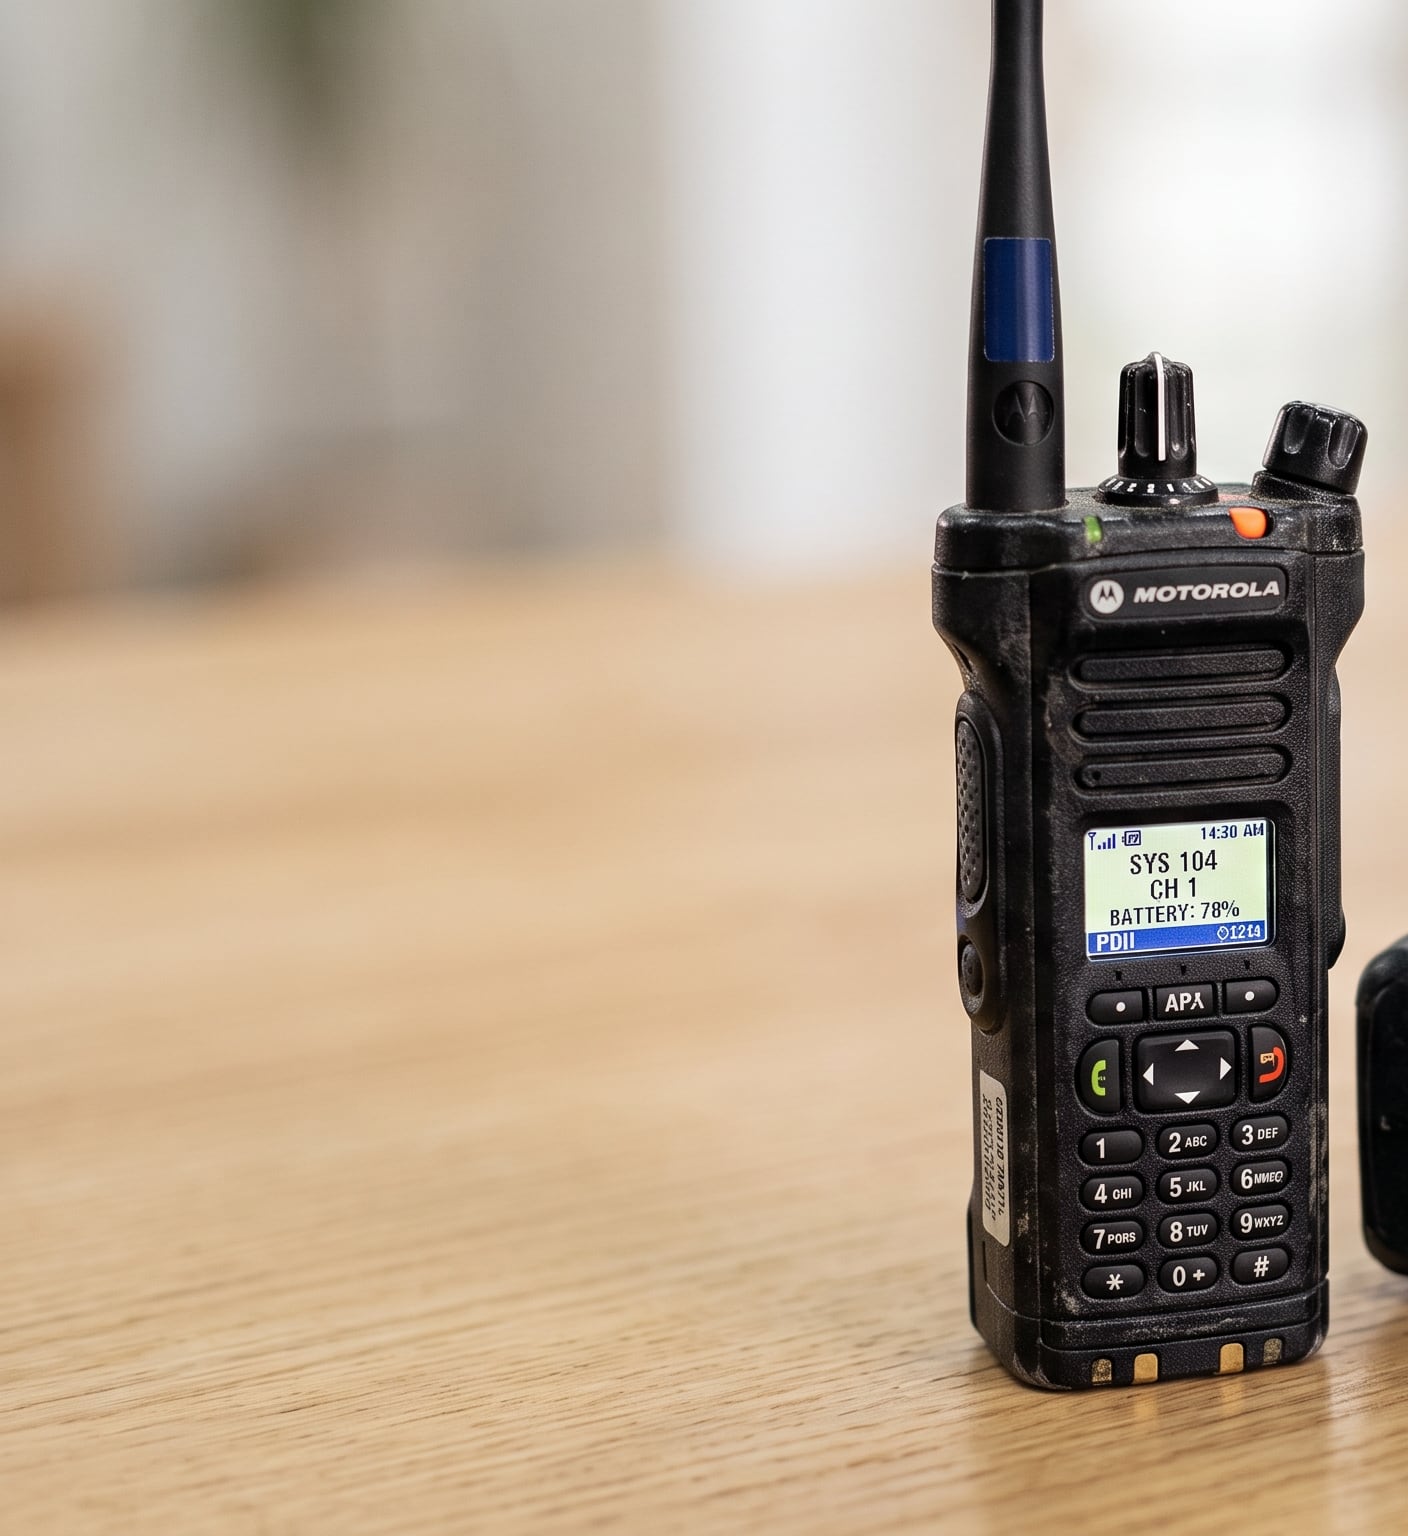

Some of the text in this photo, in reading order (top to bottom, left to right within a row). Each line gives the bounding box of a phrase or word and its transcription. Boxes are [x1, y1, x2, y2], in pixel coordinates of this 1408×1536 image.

[1134, 581, 1280, 603] MOTOROLA
[1200, 823, 1264, 840] 14:30 AM
[1130, 849, 1218, 875] SYS 104
[1150, 877, 1196, 900] CH 1
[1110, 900, 1240, 926] BATTERY: 78%
[1168, 1132, 1207, 1153] 2 ABC
[1241, 1124, 1279, 1145] 3 DEF
[1096, 1138, 1105, 1159] 1
[1169, 1177, 1207, 1197] 5 JKL
[1240, 1168, 1253, 1189] 6
[1094, 1183, 1108, 1204] 4
[1170, 1221, 1208, 1242] 8 TUV
[1240, 1212, 1284, 1234] 9 WXYZ
[1093, 1229, 1105, 1249] 7
[1172, 1266, 1186, 1287] 0
